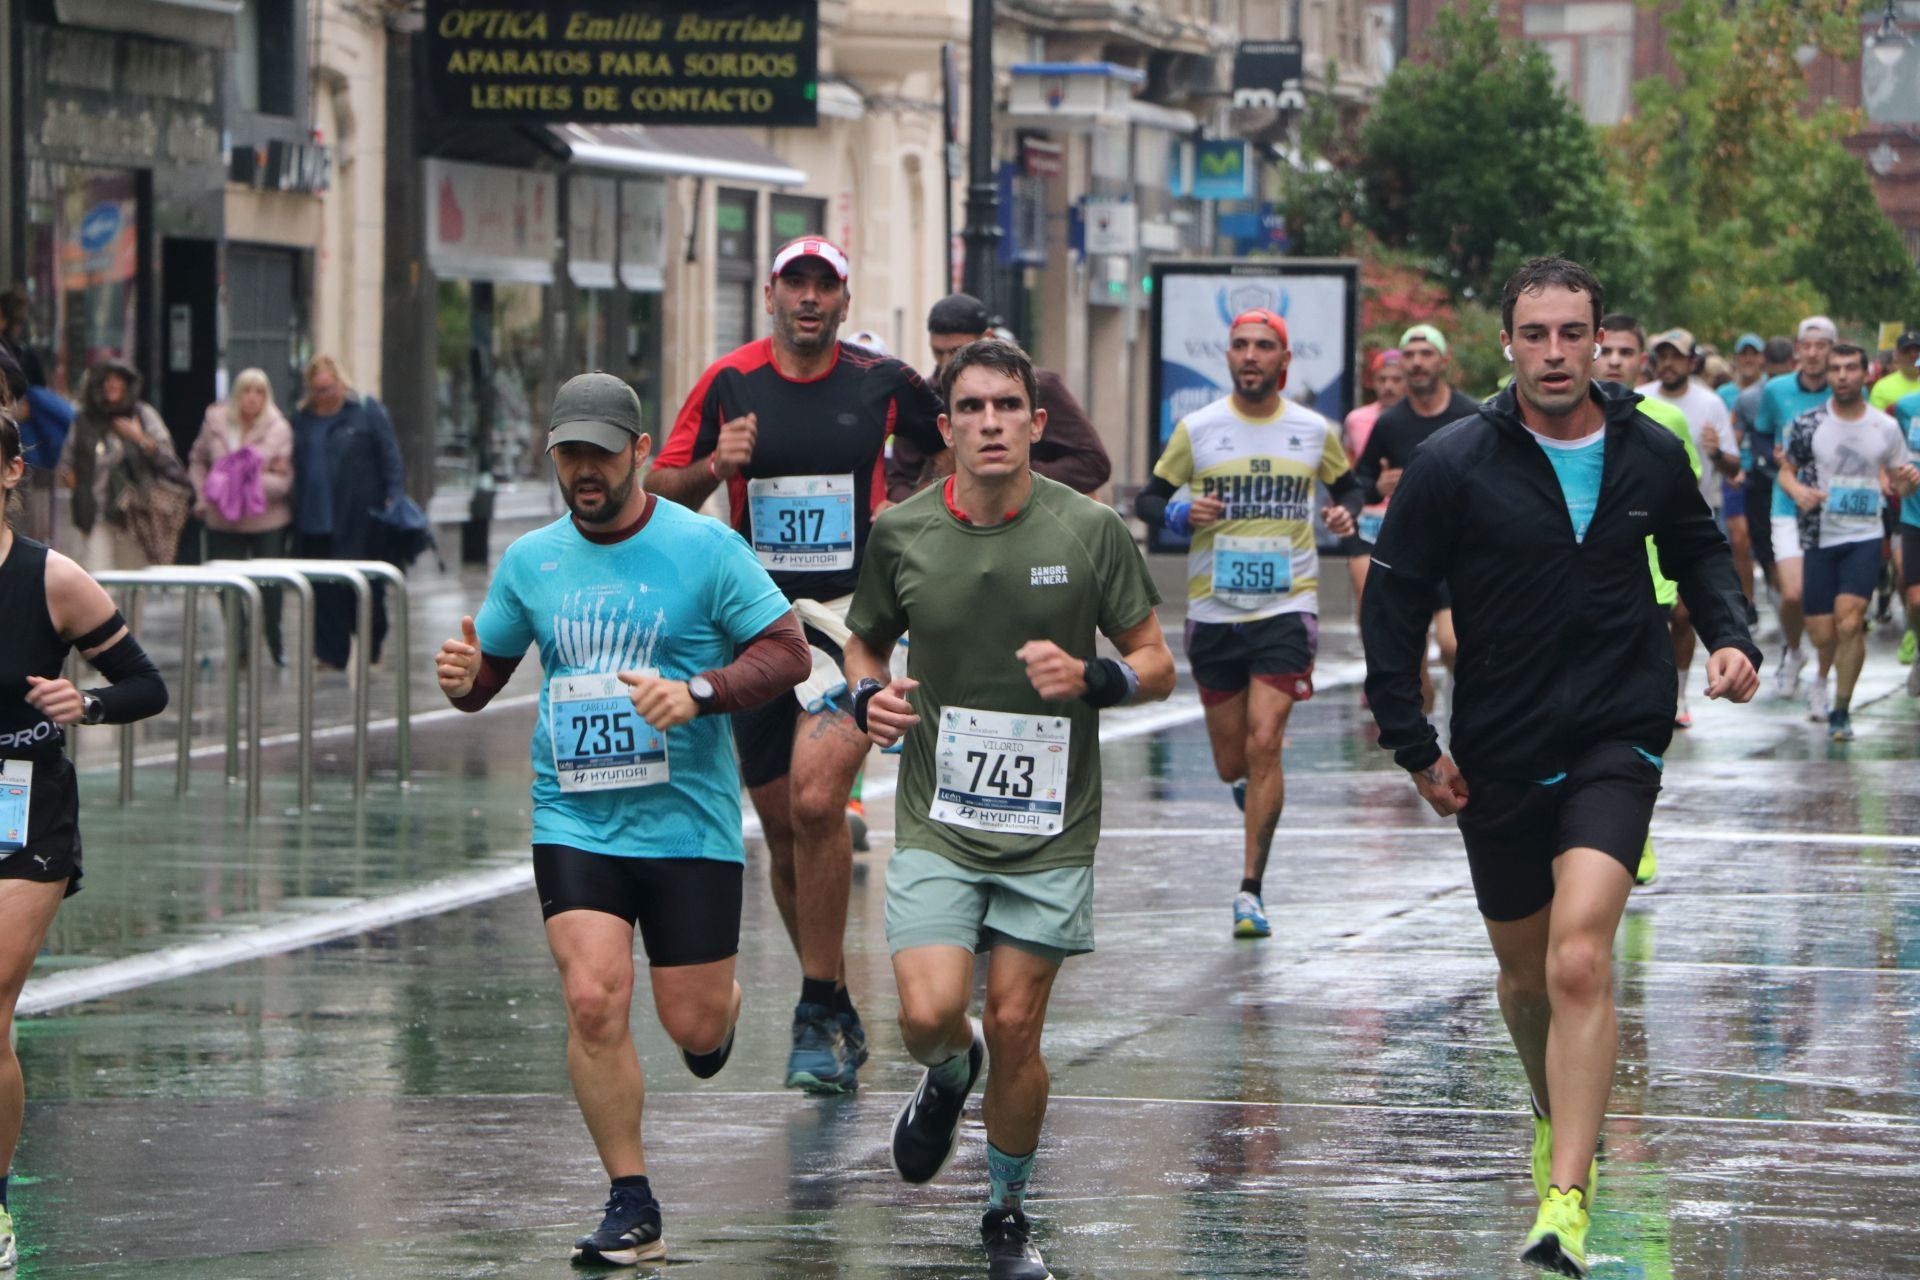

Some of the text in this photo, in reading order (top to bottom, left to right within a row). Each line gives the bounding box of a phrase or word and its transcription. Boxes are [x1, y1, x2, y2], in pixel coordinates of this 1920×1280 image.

[438, 9, 804, 42] OPTICA Emilia Barriada
[447, 50, 797, 78] APARATOS PARA SORDOS
[471, 84, 773, 112] LENTES DE CONTACTO
[1249, 458, 1271, 473] 59
[779, 509, 824, 542] 317
[790, 554, 838, 564] HYUNDAI
[1030, 565, 1068, 576] SANGRE
[1030, 575, 1069, 585] MINERA
[1231, 561, 1274, 588] 359
[572, 712, 636, 757] 235
[590, 766, 647, 781] HYUNDAI
[967, 750, 1035, 798] 743
[981, 811, 1039, 825] HYUNDAI
